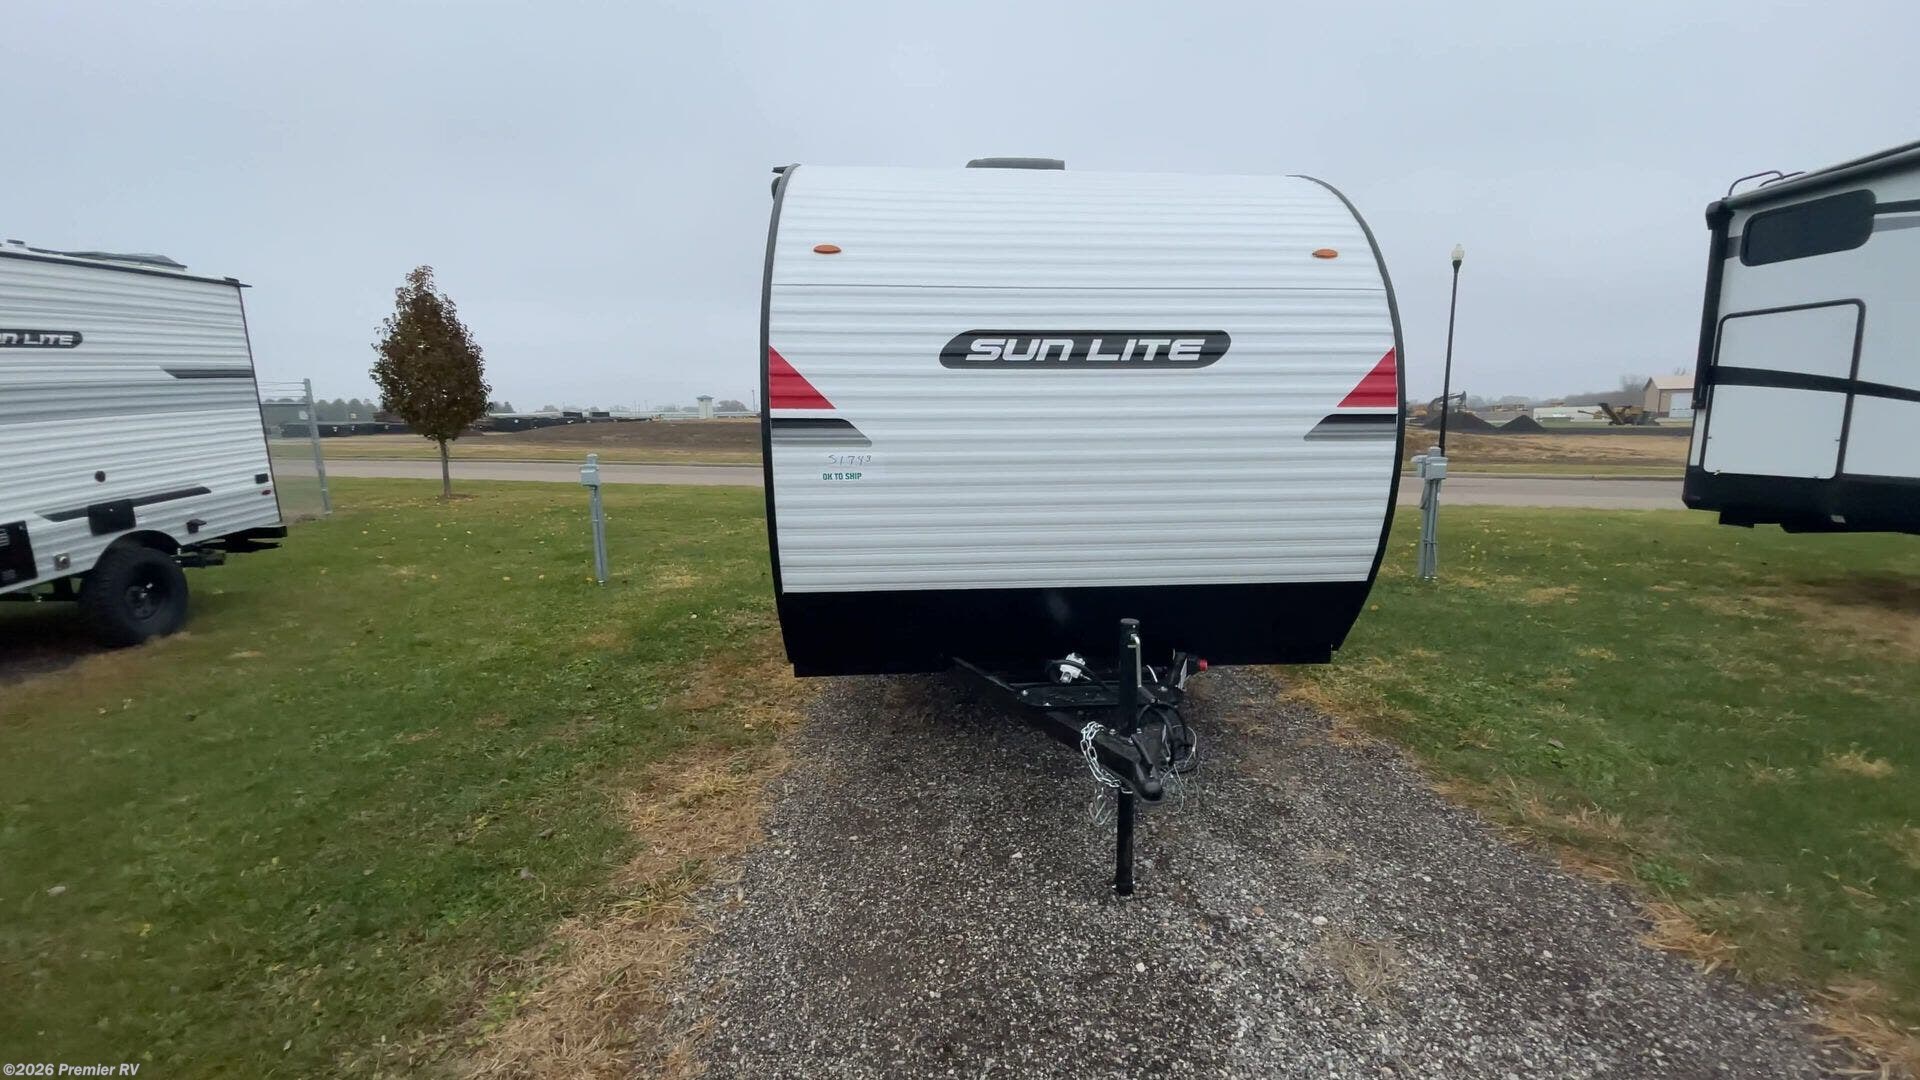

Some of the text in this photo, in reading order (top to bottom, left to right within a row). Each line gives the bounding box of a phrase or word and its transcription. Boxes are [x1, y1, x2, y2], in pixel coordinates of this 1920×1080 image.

[23, 333, 74, 346] LITE
[965, 338, 1206, 361] SUN LITE
[822, 472, 862, 481] OK TO SHIP
